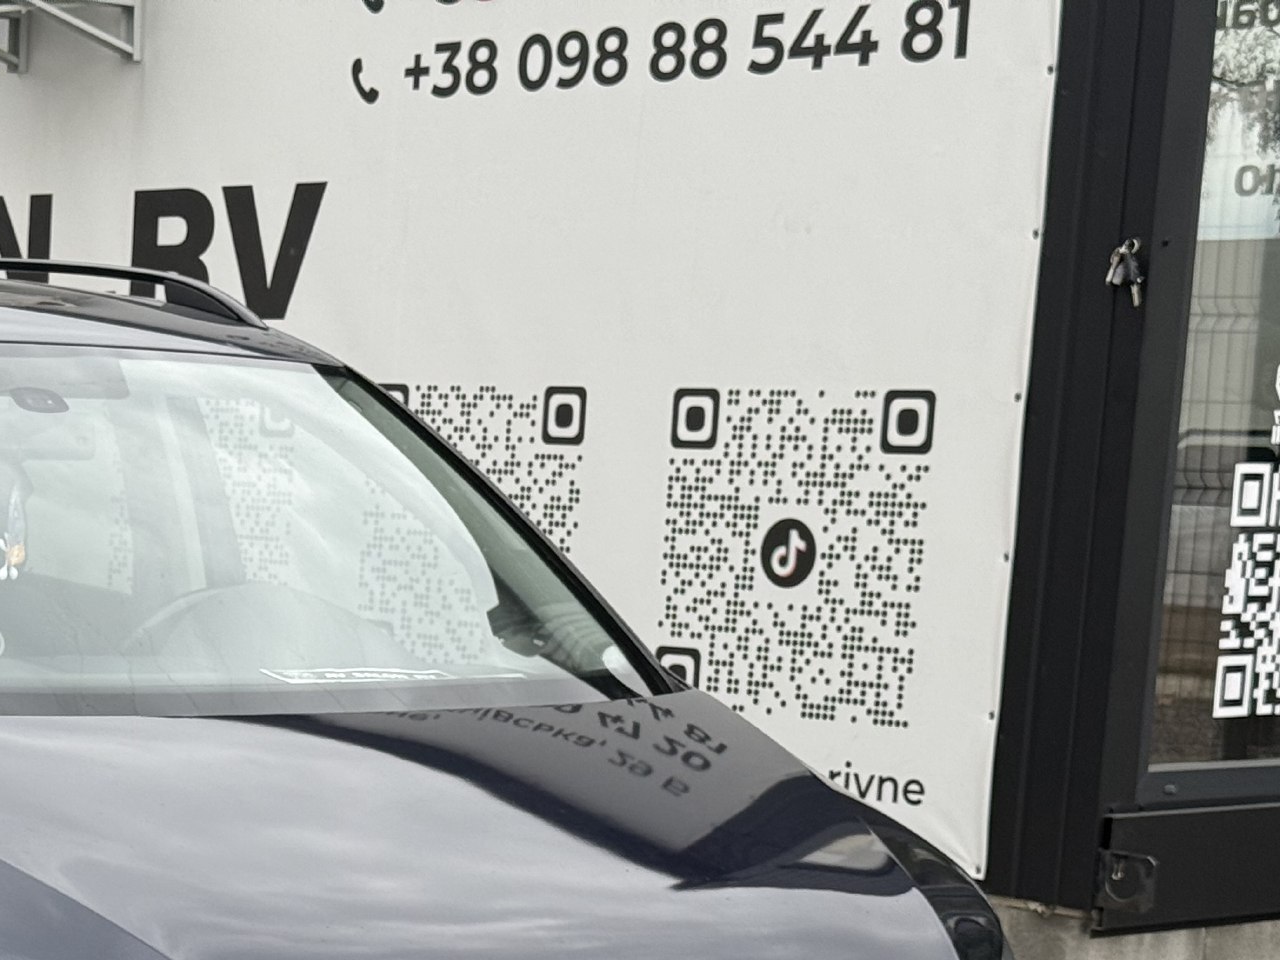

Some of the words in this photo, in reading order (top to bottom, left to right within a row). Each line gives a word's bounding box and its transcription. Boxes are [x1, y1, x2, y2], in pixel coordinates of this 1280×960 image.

[404, 38, 498, 98] +38
[518, 27, 628, 92] 098
[649, 18, 728, 82] 88
[747, 4, 879, 75] 544
[900, 0, 972, 63] 81
[130, 181, 328, 320] RV
